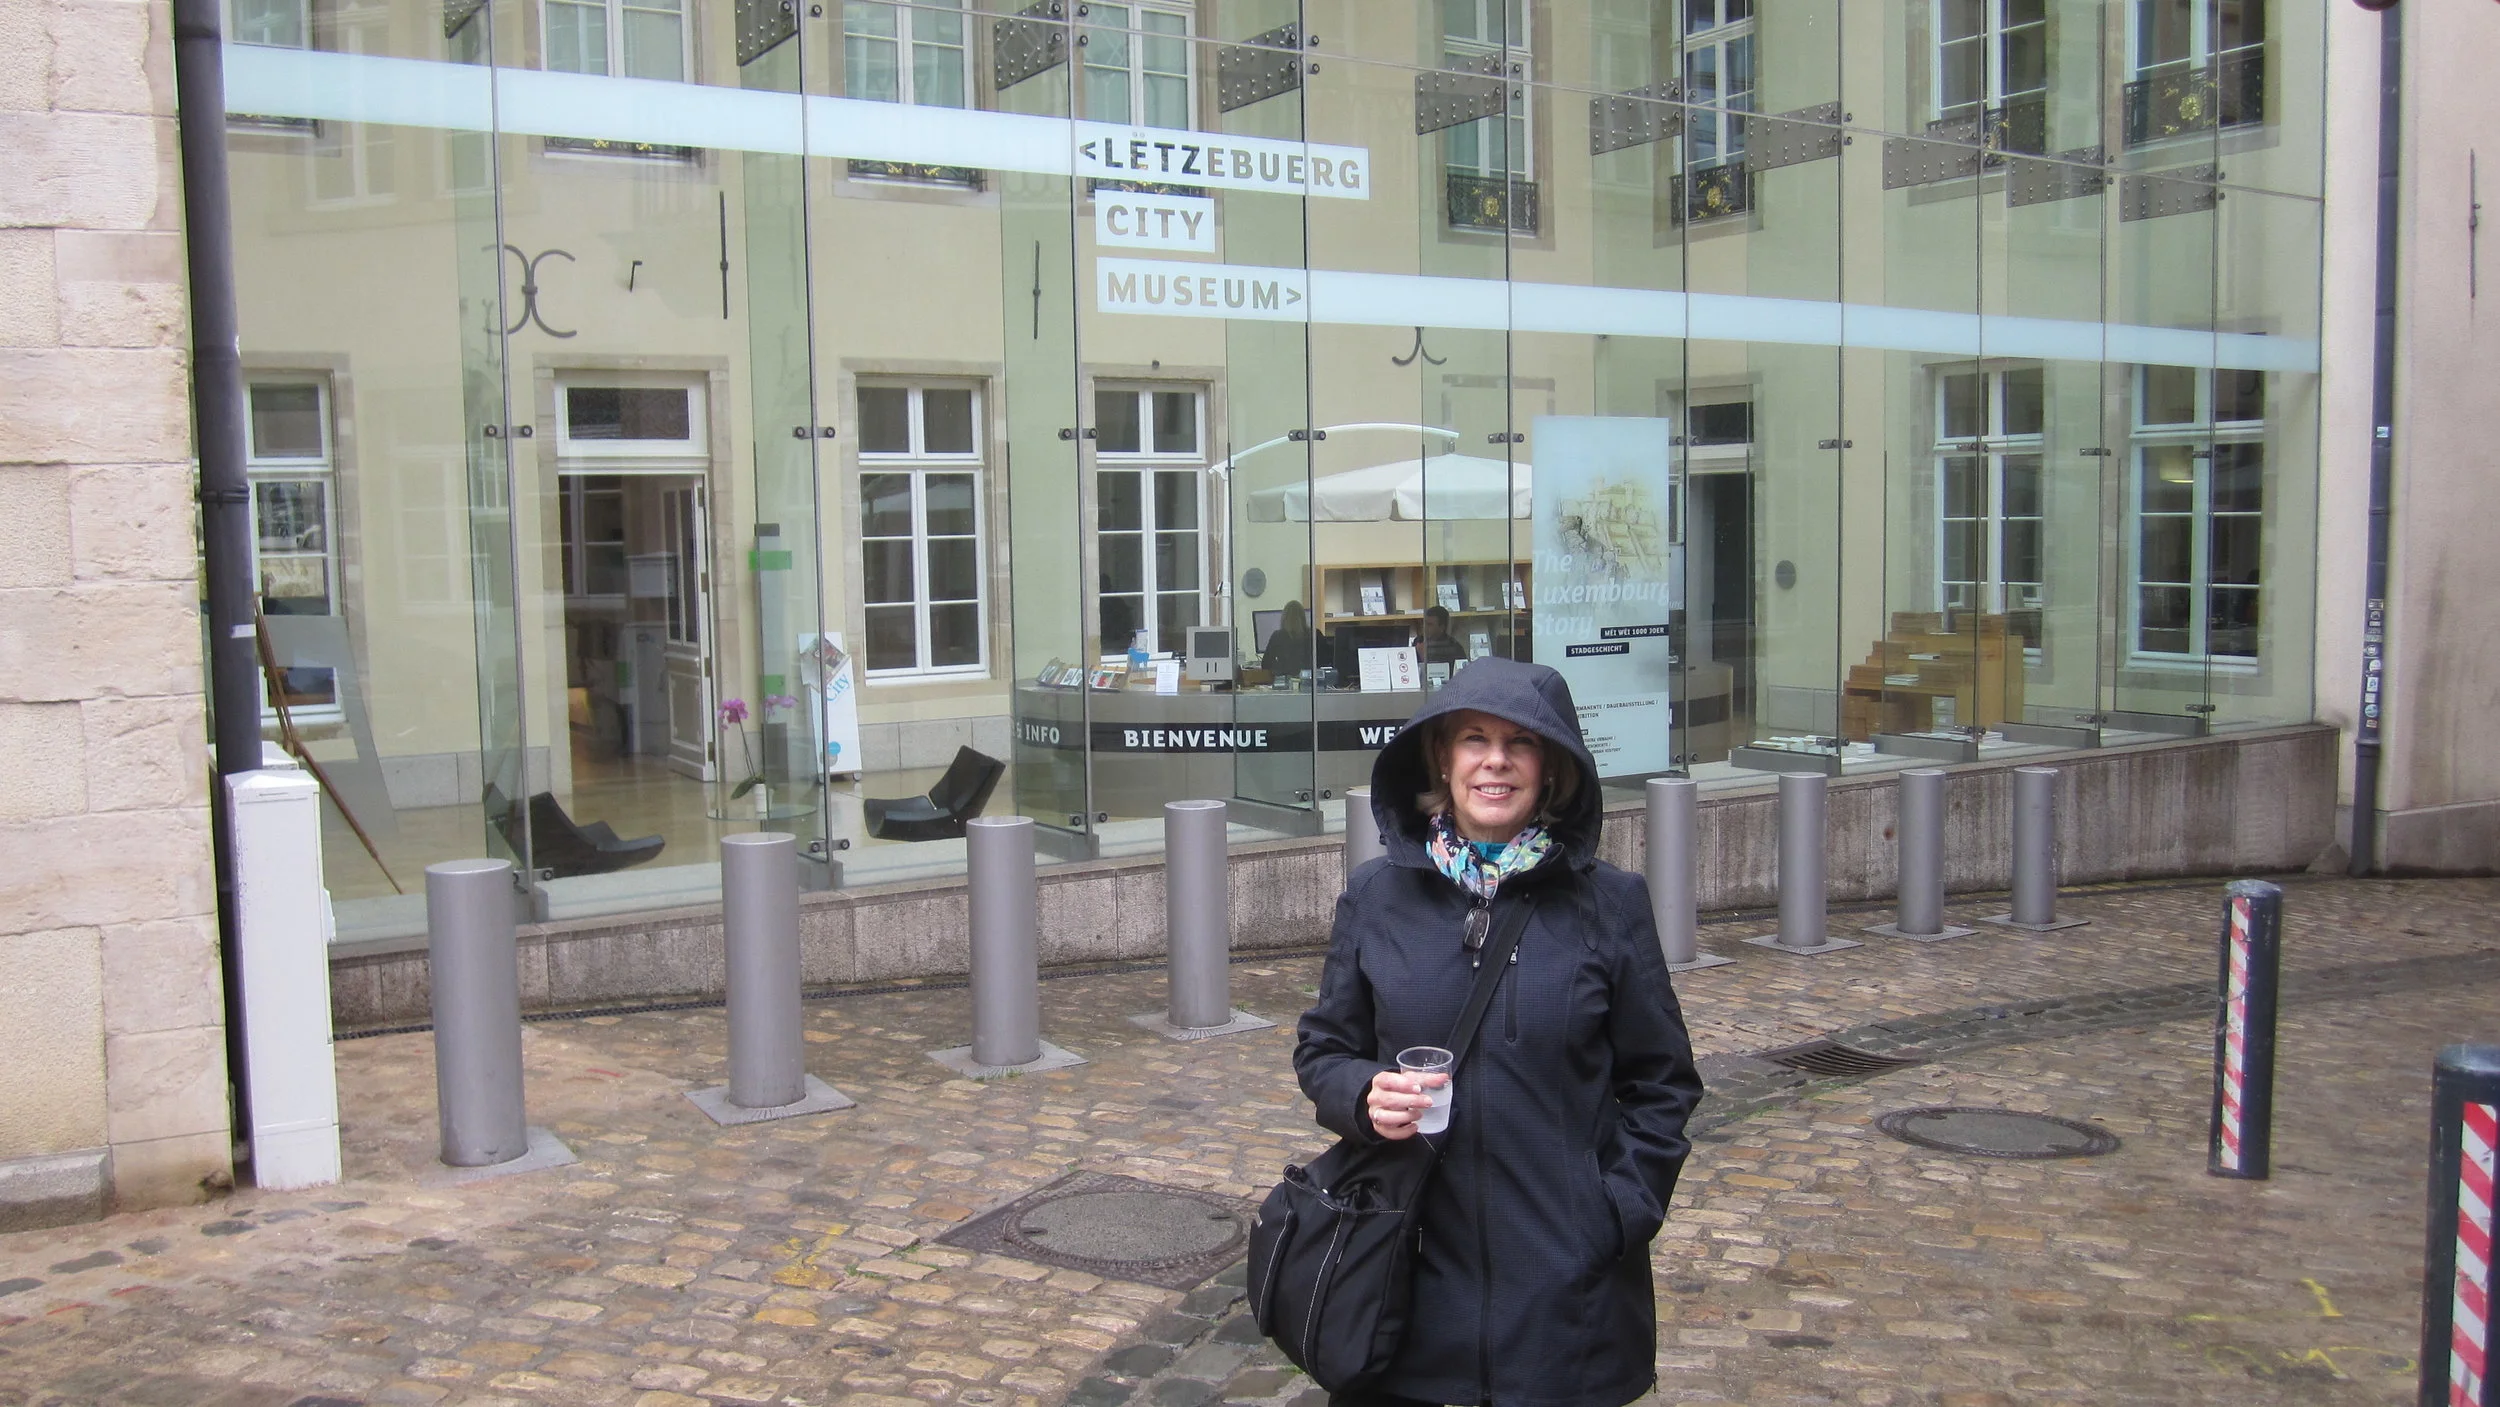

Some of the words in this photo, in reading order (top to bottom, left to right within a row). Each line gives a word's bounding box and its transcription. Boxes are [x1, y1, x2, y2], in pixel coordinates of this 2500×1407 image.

[1106, 205, 1204, 240] CITY
[1532, 549, 1573, 573] The
[1533, 578, 1669, 606] Luxembourg
[1533, 612, 1594, 641] Story
[1571, 645, 1623, 655] STADGESCHICHT
[826, 673, 850, 702] City
[1025, 724, 1060, 744] INFO
[1123, 729, 1268, 748] BIENVENUE
[1359, 726, 1404, 745] WE
